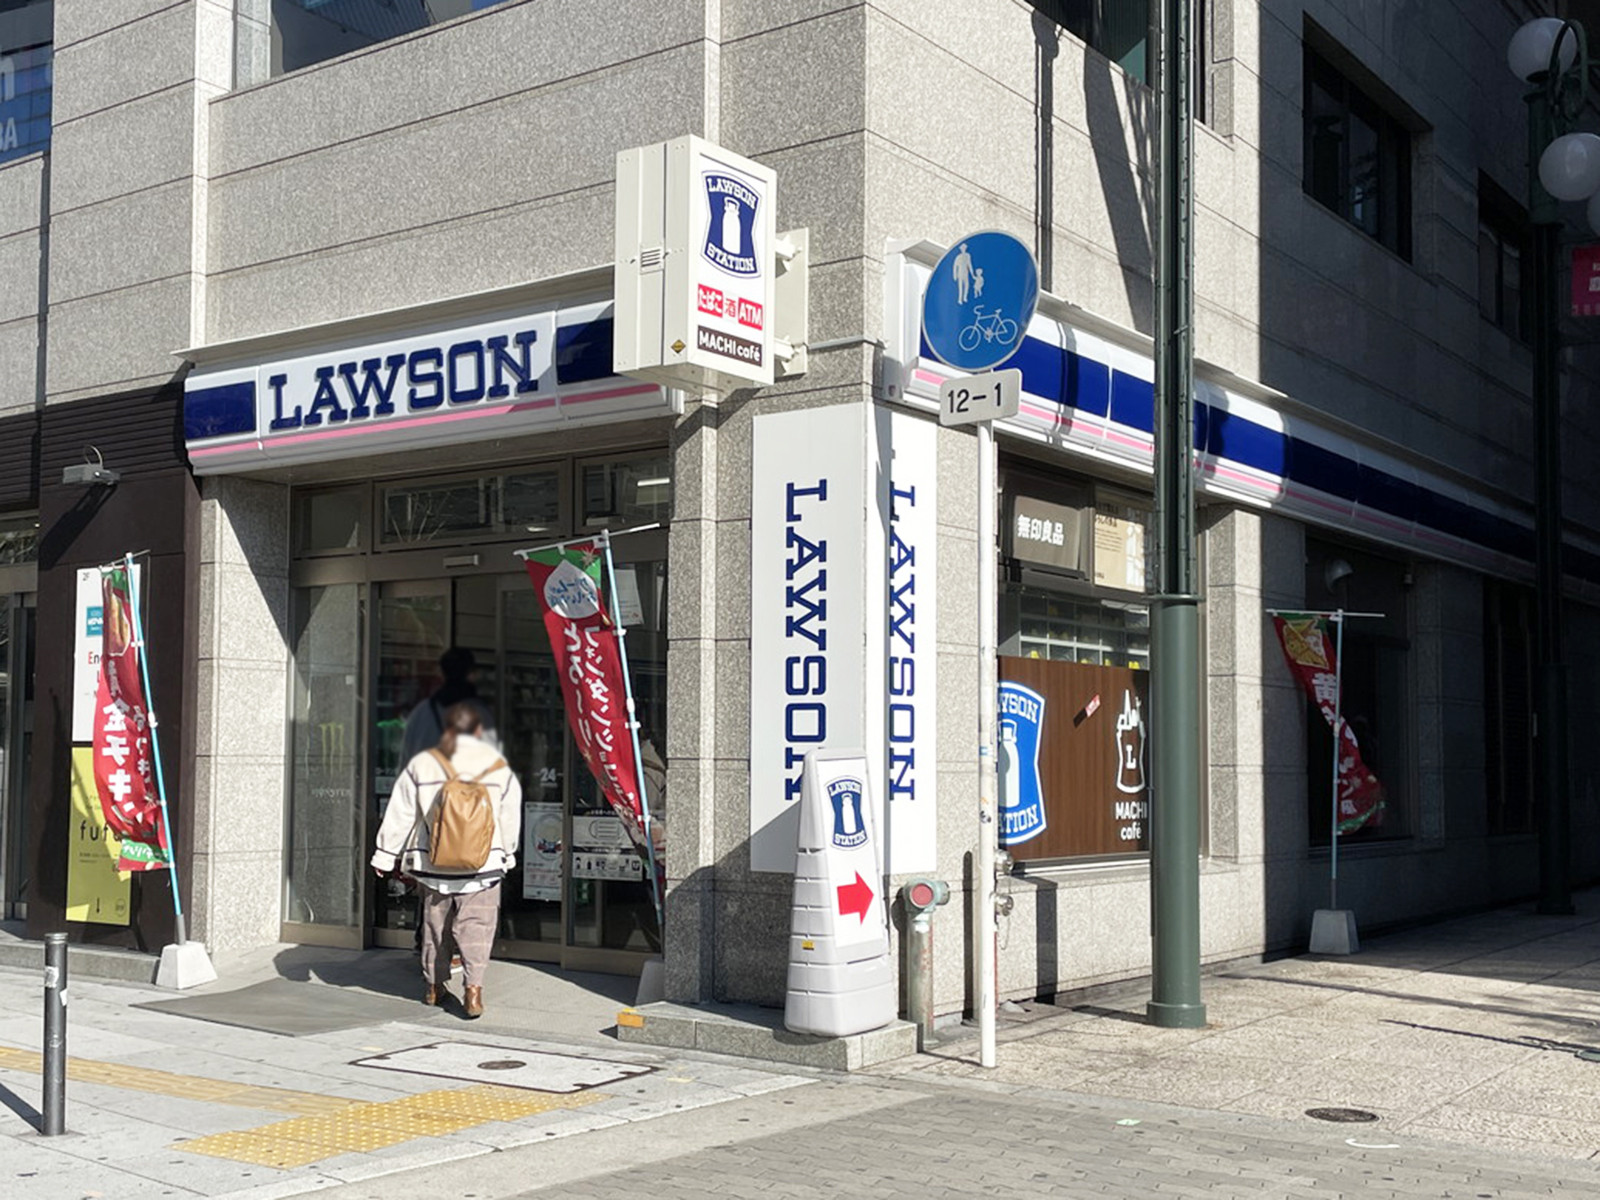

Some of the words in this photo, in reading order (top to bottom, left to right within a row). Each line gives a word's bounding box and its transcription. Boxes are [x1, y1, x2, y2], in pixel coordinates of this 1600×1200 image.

[707, 177, 758, 209] LAWSON
[708, 242, 756, 272] STATION
[739, 304, 763, 326] ATM
[699, 333, 736, 355] MACHI
[737, 344, 762, 362] café
[269, 330, 538, 431] LAWSON
[1016, 514, 1065, 547] 無印良品
[888, 481, 916, 801] LAWSON
[1115, 801, 1148, 821] MACHI
[1120, 822, 1142, 840] café
